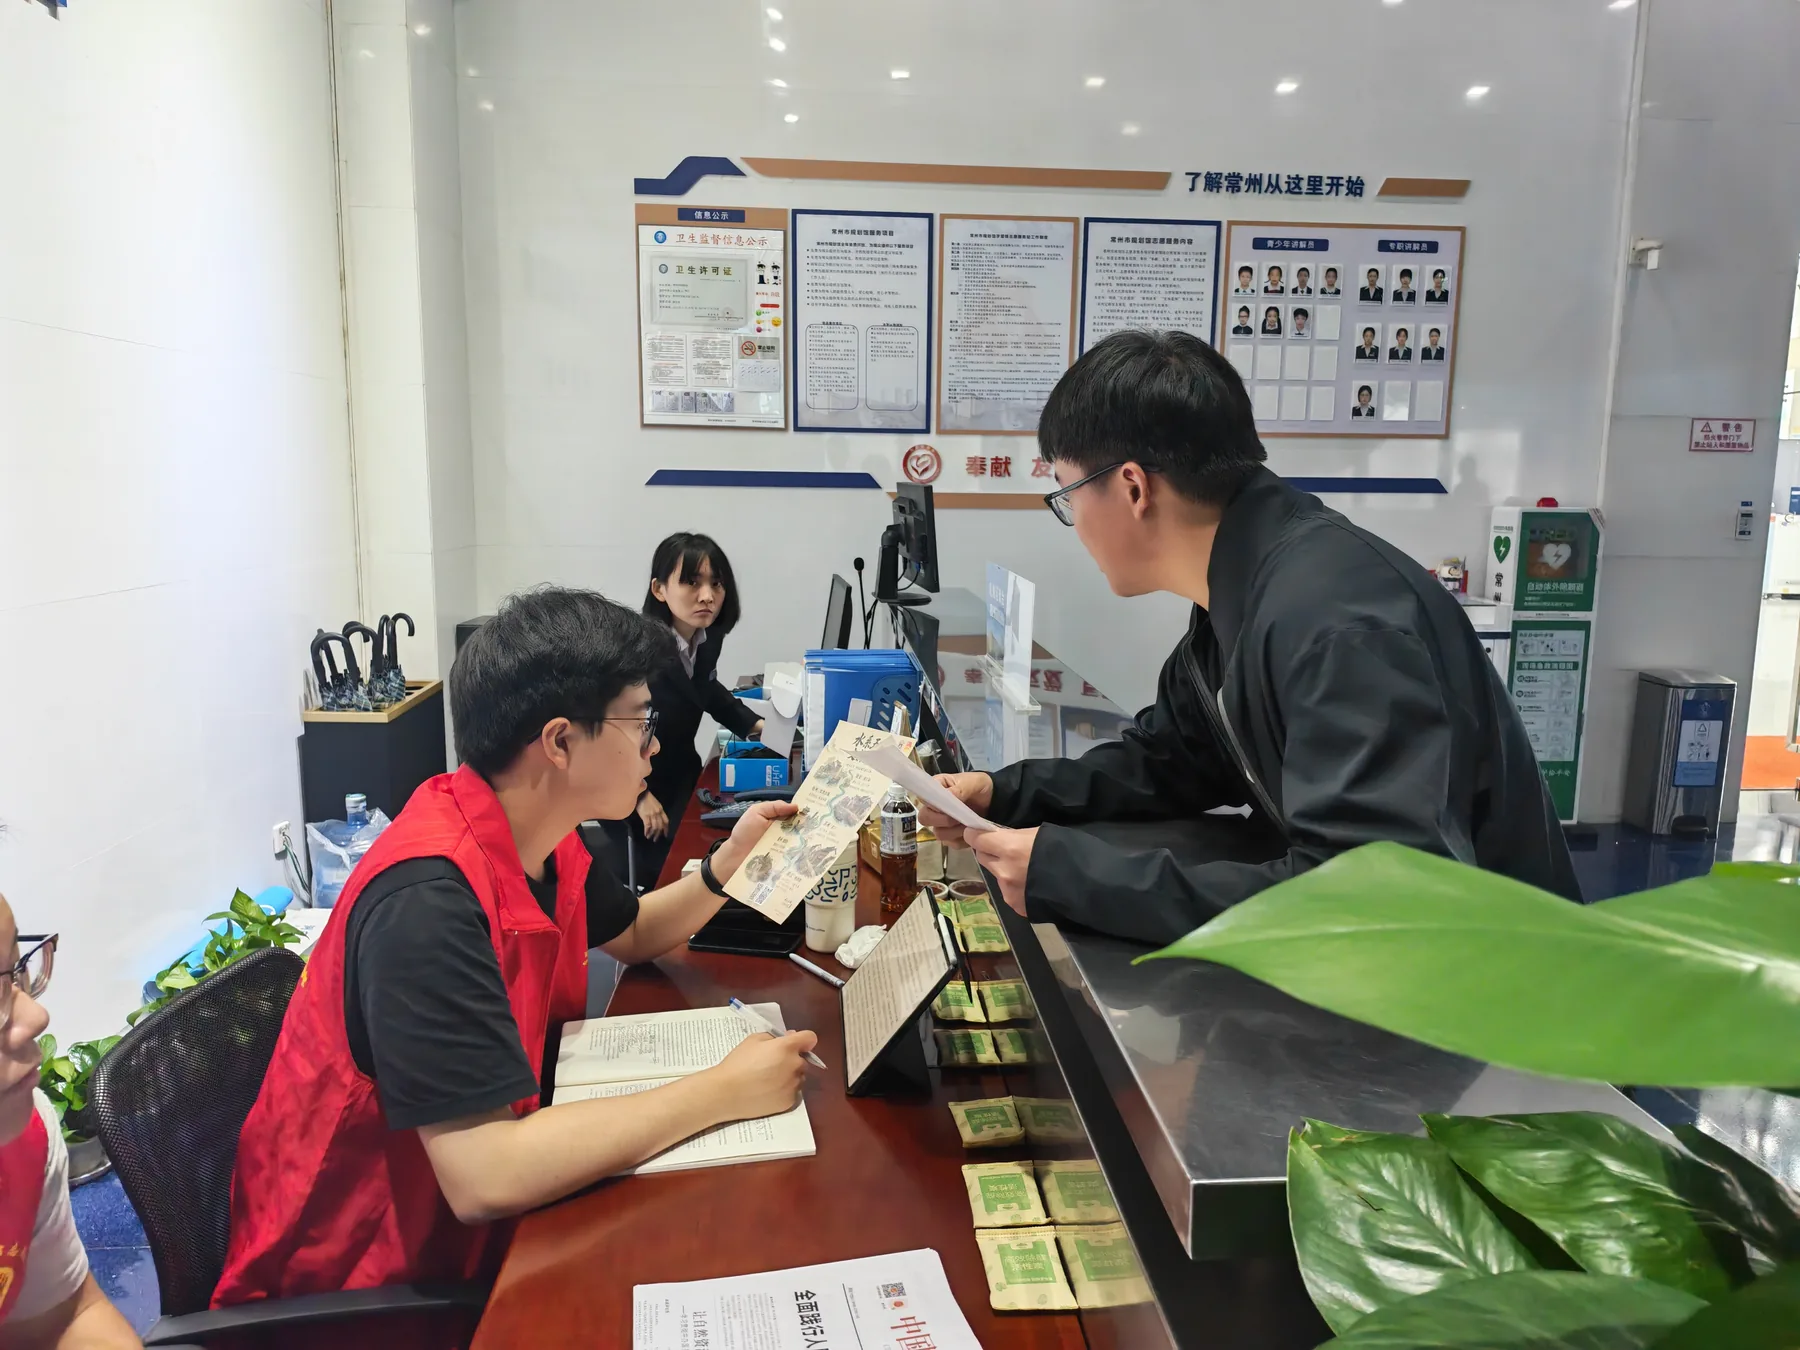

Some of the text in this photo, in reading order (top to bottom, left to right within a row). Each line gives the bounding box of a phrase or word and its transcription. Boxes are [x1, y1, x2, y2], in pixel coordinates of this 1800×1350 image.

[1184, 171, 1365, 198] 了解常州从这里开始
[694, 210, 729, 220] 信息公示
[675, 232, 769, 247] 卫生监督信息公示
[1266, 239, 1316, 250] 青少年讲解员
[1388, 242, 1429, 252] 专职讲解员
[675, 265, 733, 276] 卫生许可证
[1722, 423, 1742, 432] 警告
[965, 455, 1012, 478] 奉献
[772, 764, 781, 787] UHF
[794, 1289, 830, 1350] 全面践行人
[692, 1310, 711, 1350] 让自然资
